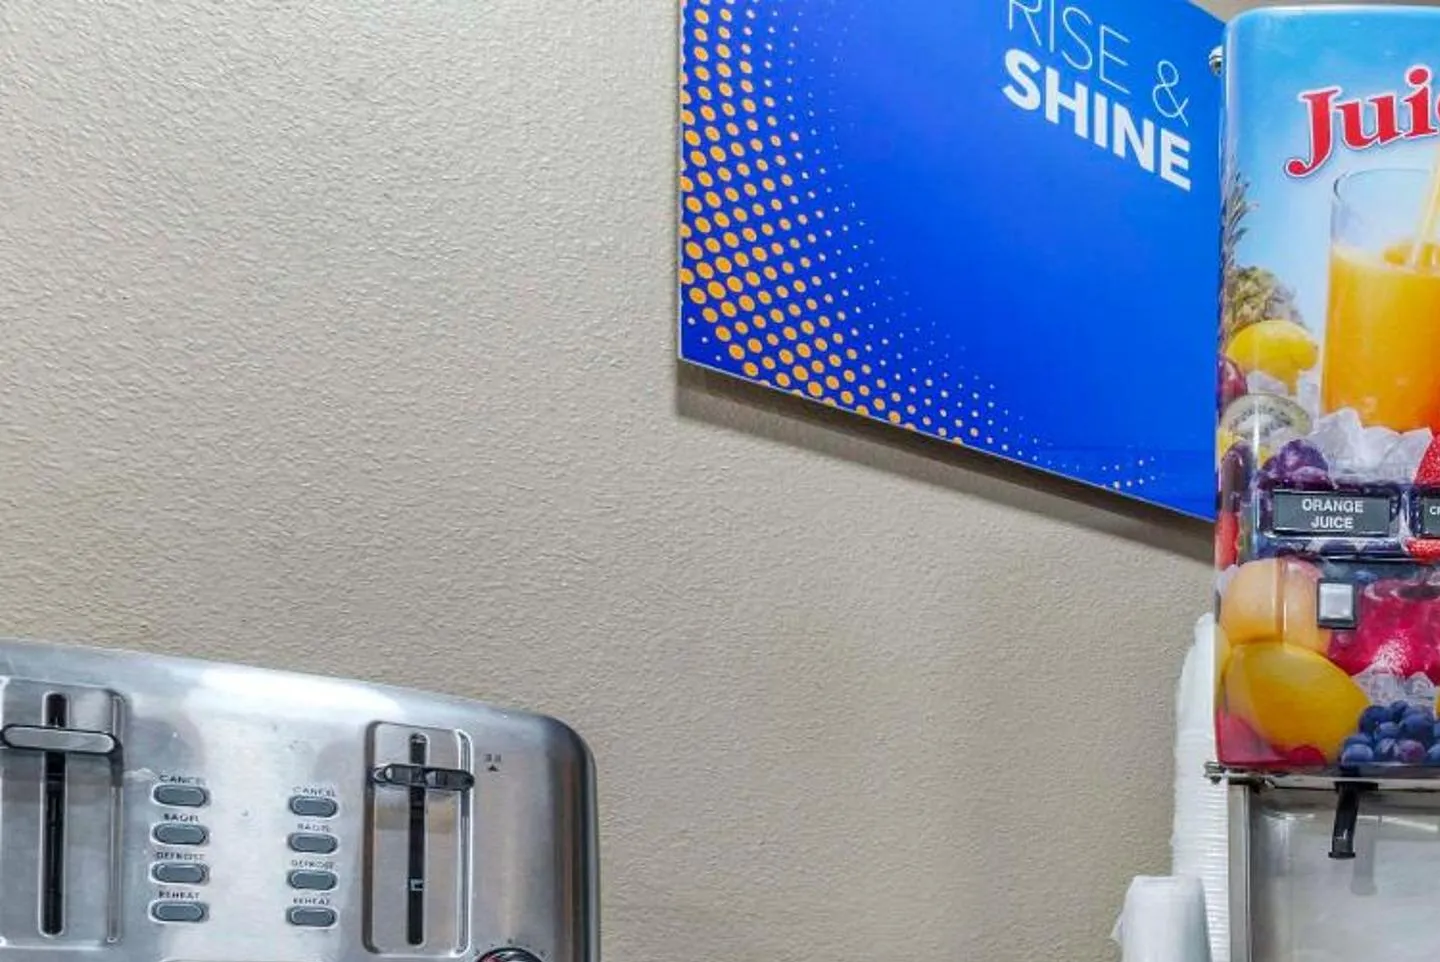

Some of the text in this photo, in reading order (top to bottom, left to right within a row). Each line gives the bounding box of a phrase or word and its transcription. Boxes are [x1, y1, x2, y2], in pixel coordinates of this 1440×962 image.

[1008, 0, 1189, 128] RISE &
[1002, 48, 1191, 192] SHINE
[1301, 498, 1364, 513] ORANGE
[1311, 516, 1354, 530] JUICE
